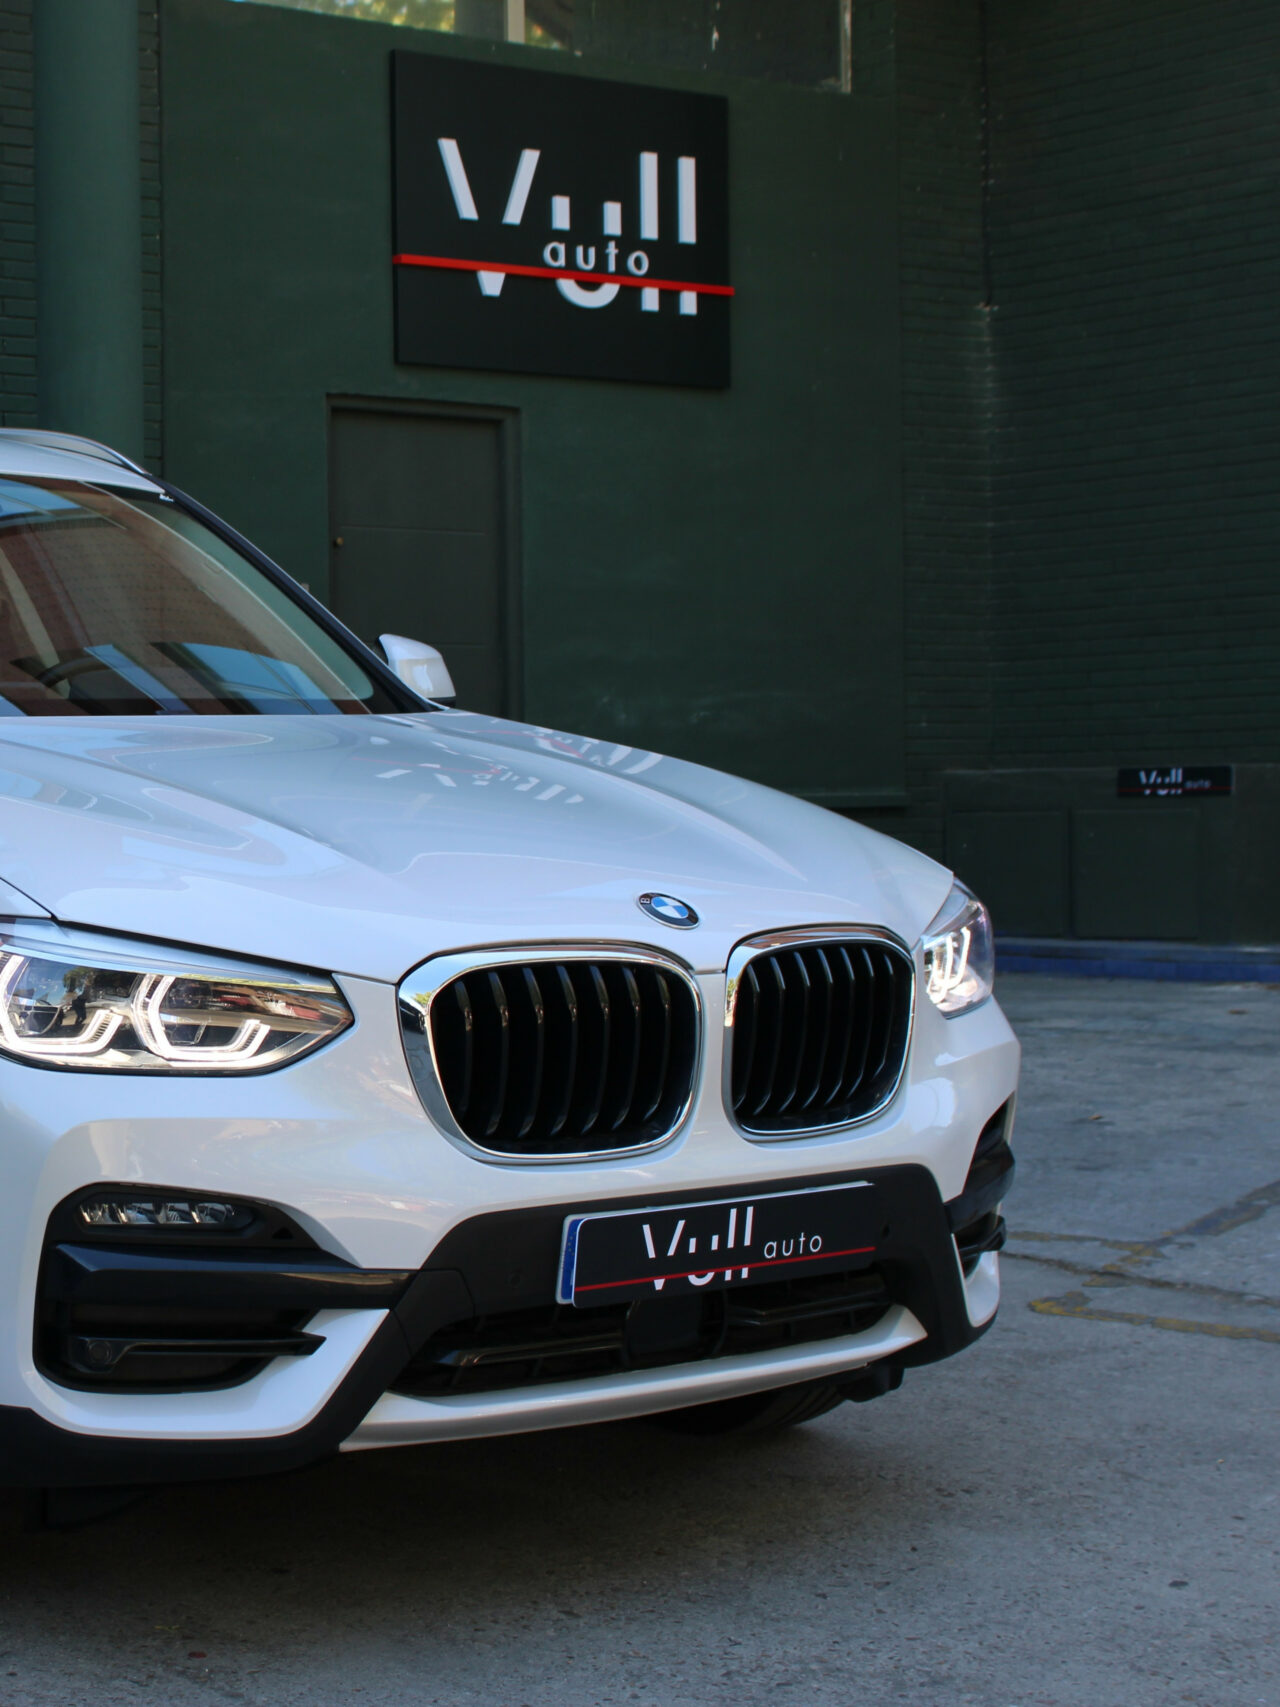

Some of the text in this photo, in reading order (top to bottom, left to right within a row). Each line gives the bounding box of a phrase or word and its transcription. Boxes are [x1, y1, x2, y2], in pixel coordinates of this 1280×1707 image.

[437, 137, 697, 316] Vull
[543, 240, 650, 276] auto
[642, 1205, 822, 1291] Vull auto
